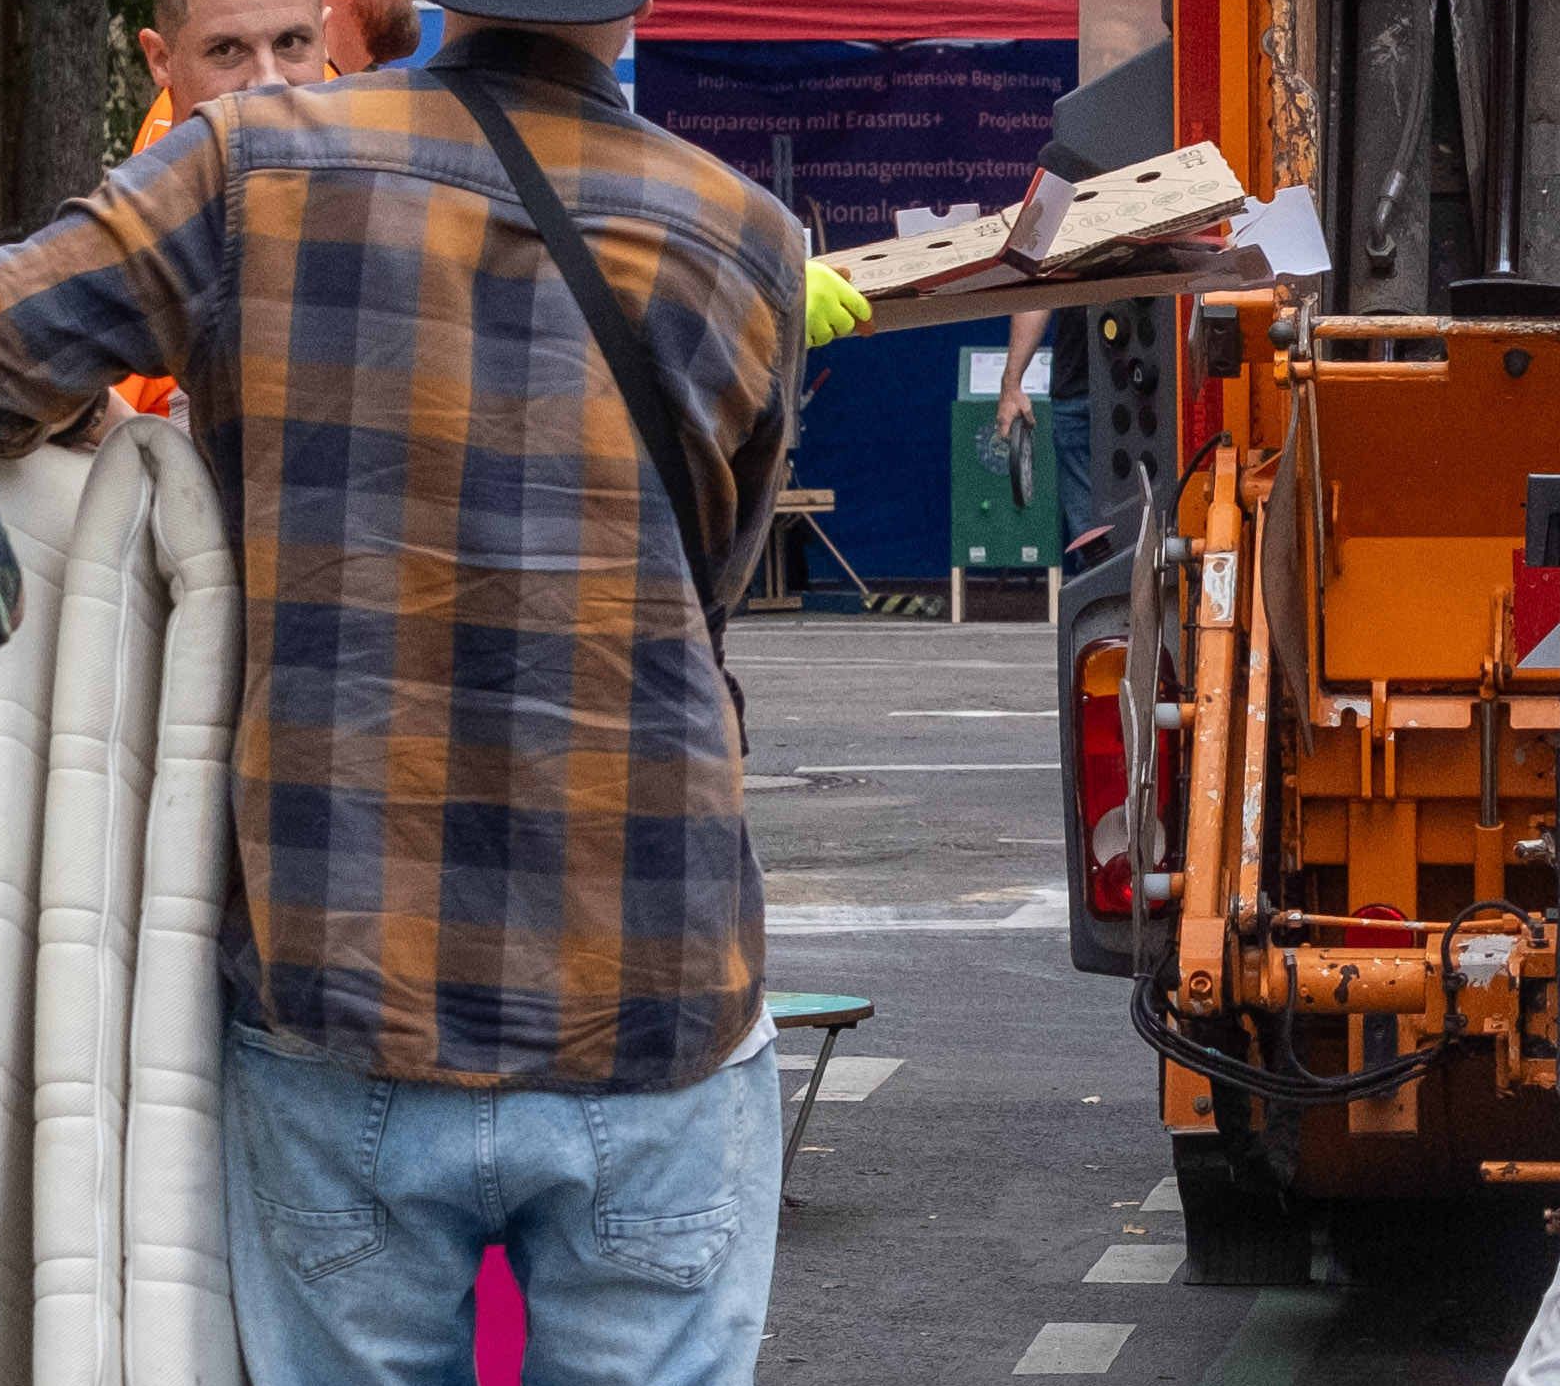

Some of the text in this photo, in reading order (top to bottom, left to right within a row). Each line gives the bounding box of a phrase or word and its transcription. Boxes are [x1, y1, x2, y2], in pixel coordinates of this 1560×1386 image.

[971, 69, 1062, 92] Begleitung
[666, 111, 801, 135] Europareisen
[806, 112, 841, 130] mit
[845, 111, 945, 130] Erasmus+
[790, 159, 1037, 183] ernmanagementsysteme
